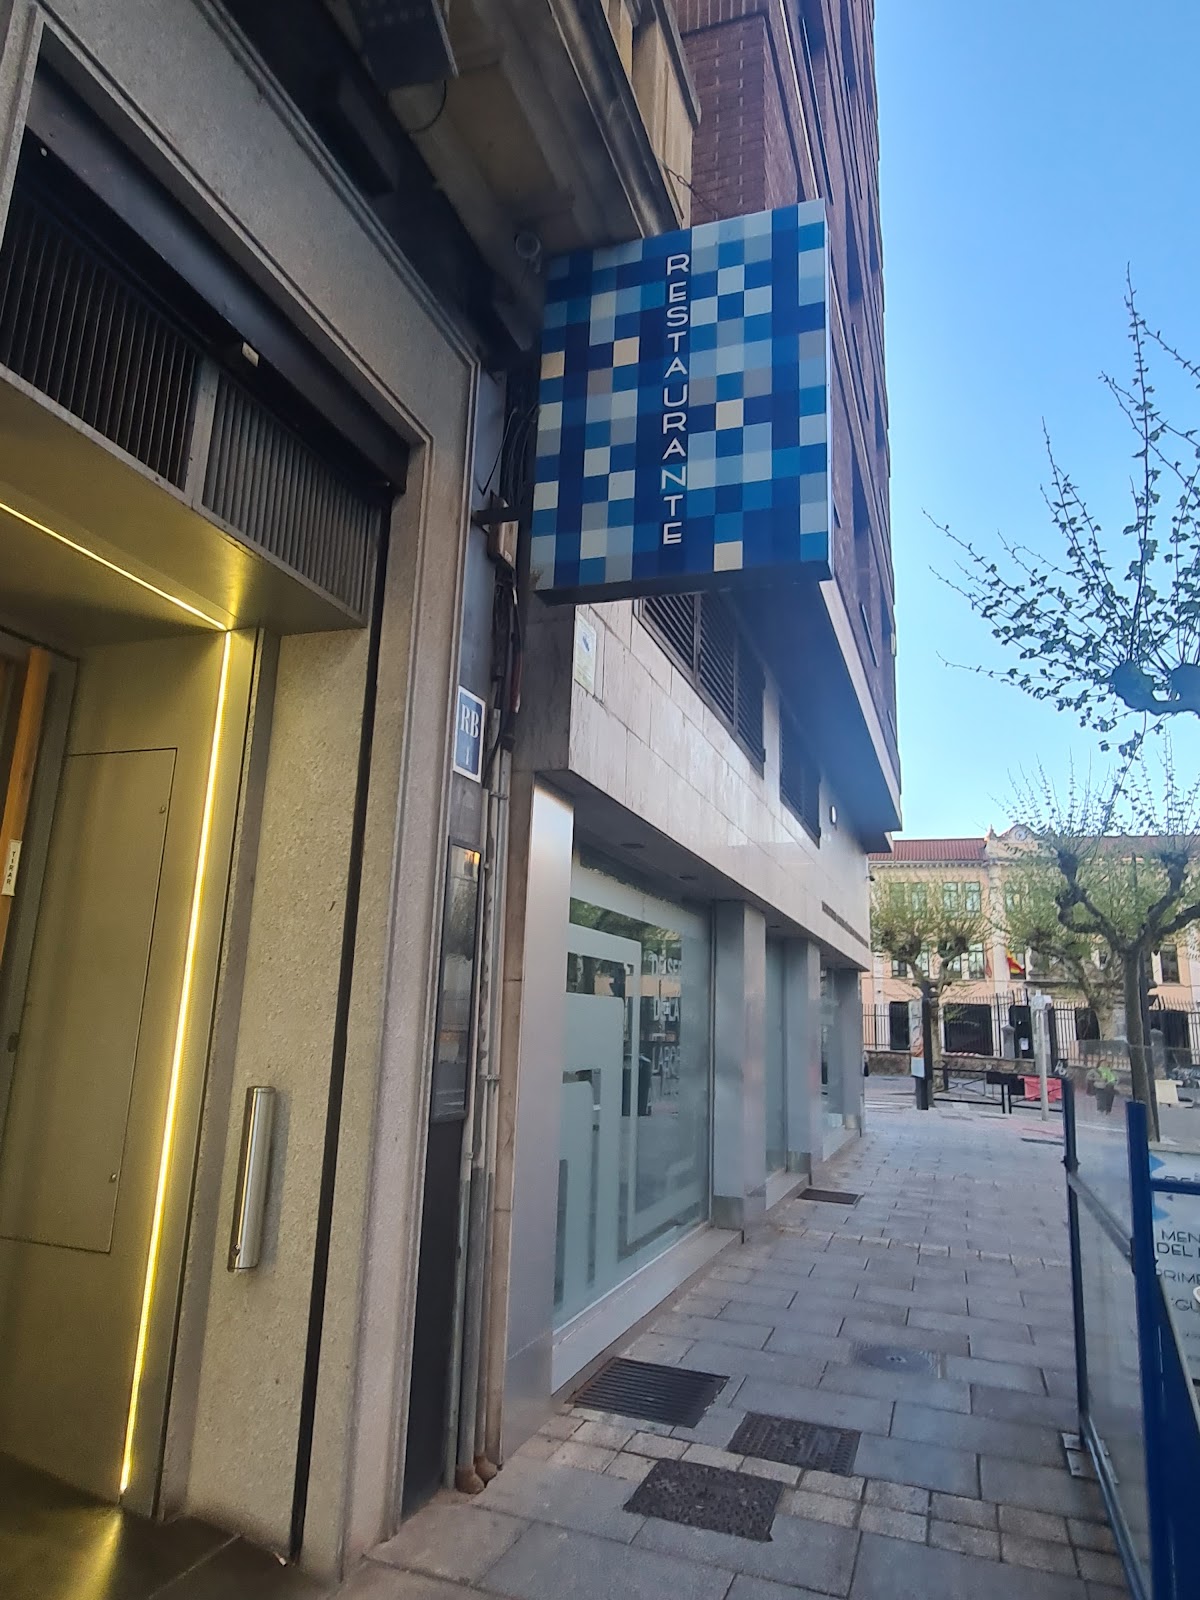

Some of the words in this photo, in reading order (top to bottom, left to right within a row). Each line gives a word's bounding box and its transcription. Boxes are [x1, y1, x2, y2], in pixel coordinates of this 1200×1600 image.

[661, 253, 690, 545] RESTAURANTE
[460, 703, 480, 738] RB
[6, 850, 16, 885] TIRAR
[1156, 1242, 1193, 1257] DEL
